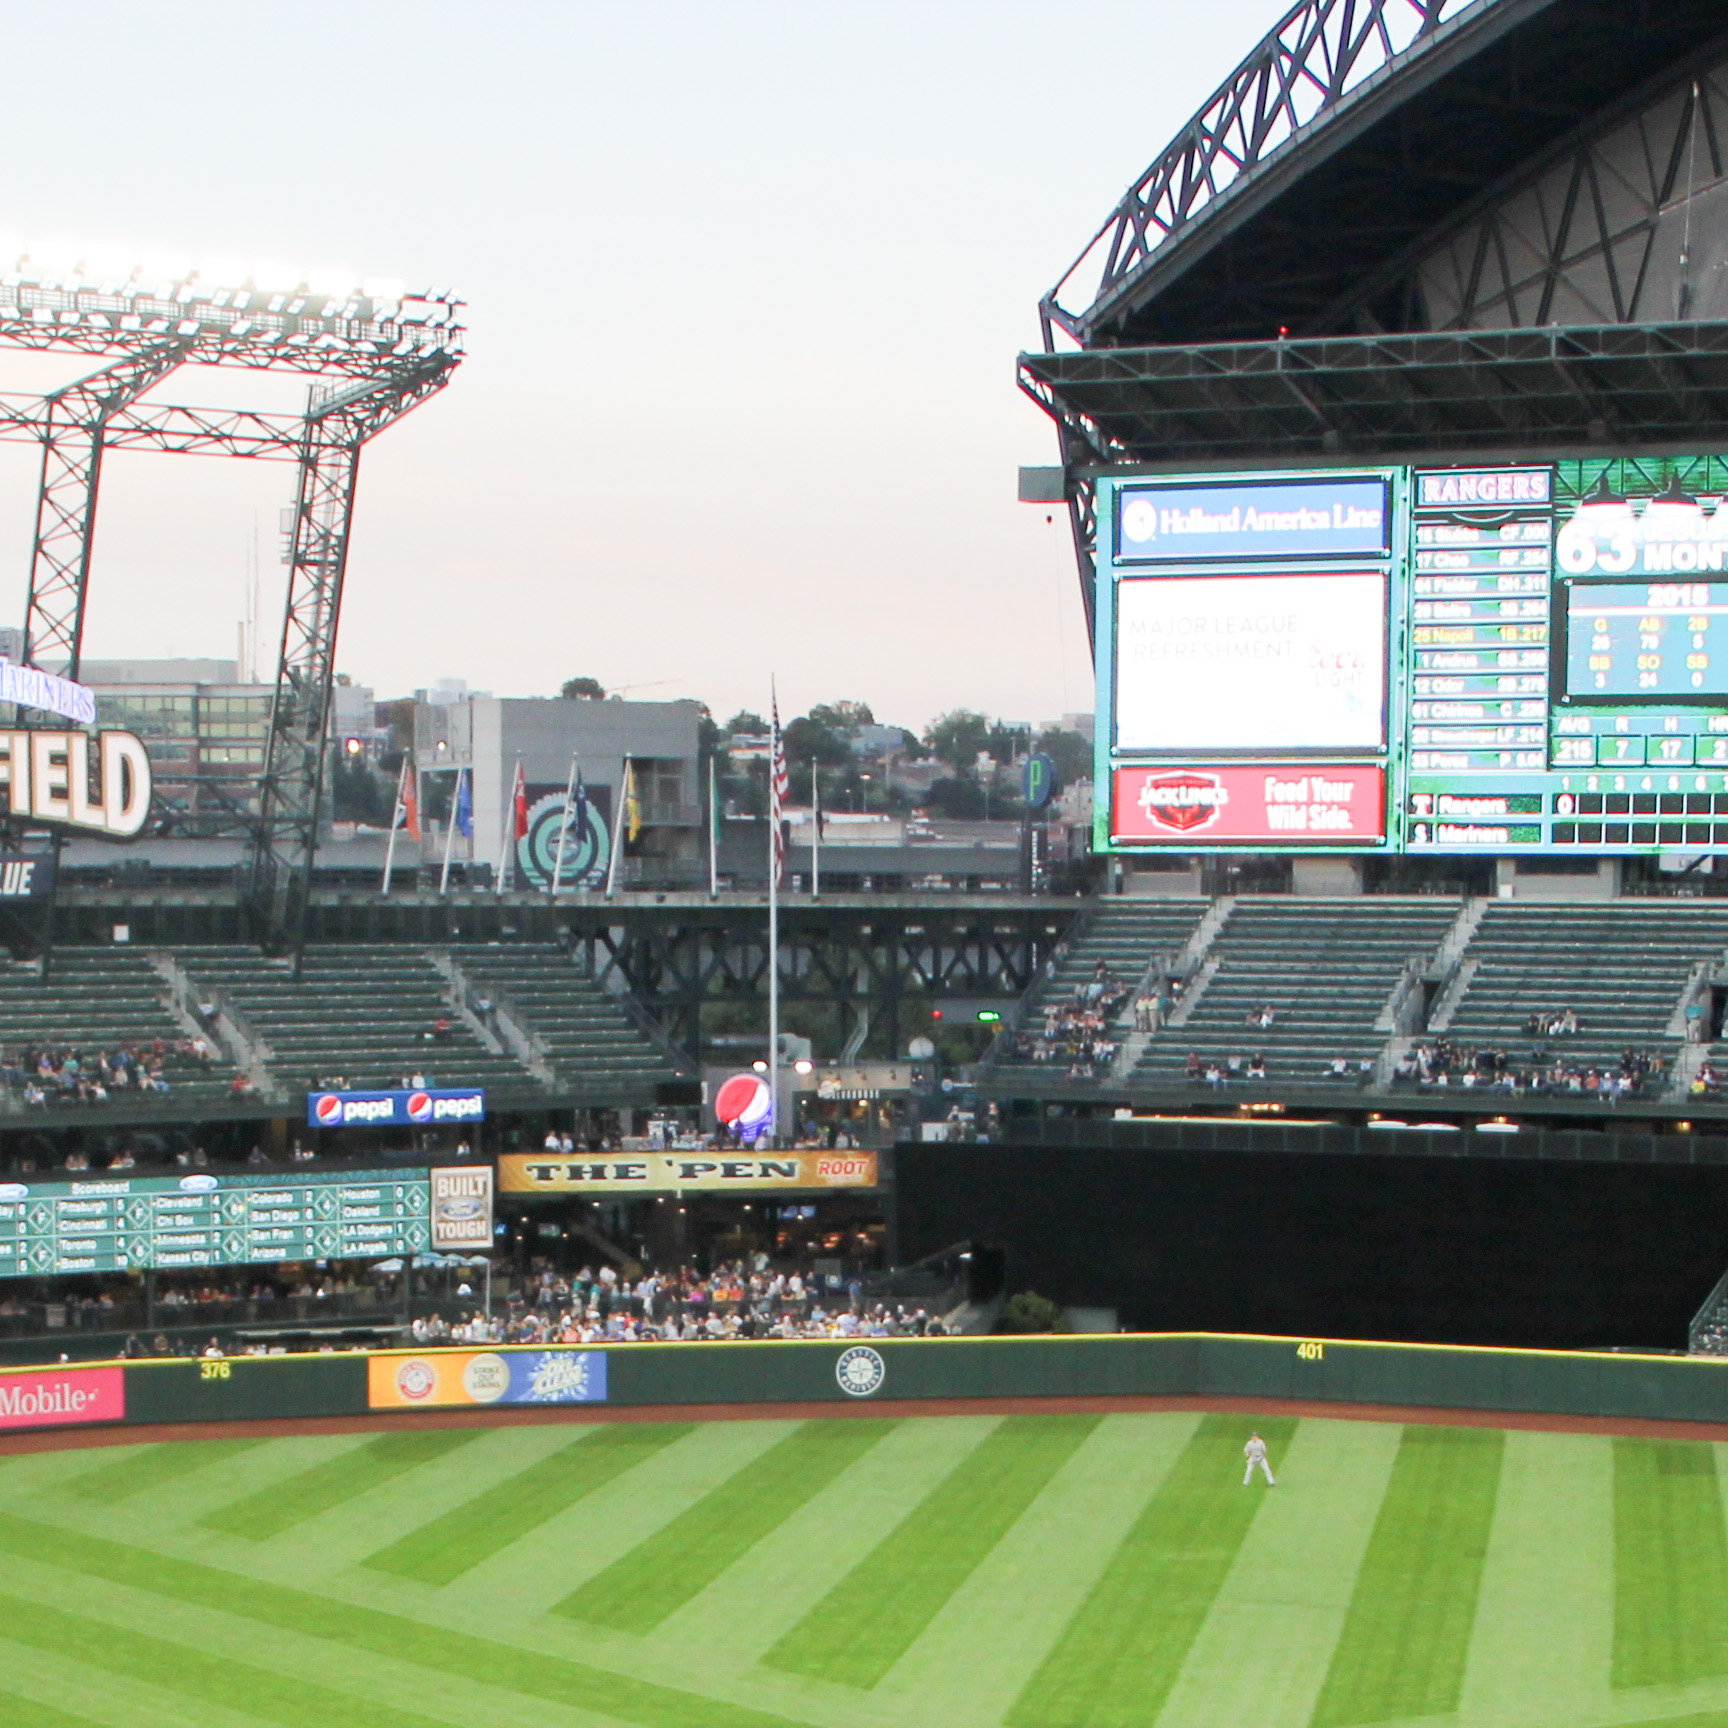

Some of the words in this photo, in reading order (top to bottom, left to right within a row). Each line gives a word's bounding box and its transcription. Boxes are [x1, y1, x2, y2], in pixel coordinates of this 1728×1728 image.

[1424, 473, 1546, 502] RANGERS
[1160, 507, 1240, 535] Holland
[1242, 504, 1329, 532] America
[1332, 503, 1380, 529] Line
[1556, 517, 1637, 573] 63
[1647, 583, 1710, 606] 2015
[1558, 716, 1591, 732] AVG
[1557, 740, 1592, 759] .215
[1616, 739, 1628, 757] 7
[1660, 739, 1682, 757] 17
[1713, 739, 1728, 757] 2
[1264, 776, 1308, 804] Feed
[1310, 776, 1355, 803] Your
[1267, 803, 1309, 830] Wild
[1439, 795, 1509, 817] Rangers
[1439, 823, 1509, 843] Mariners
[343, 1098, 394, 1122] pepsi
[434, 1095, 483, 1119] pepsi
[526, 1162, 648, 1181] THE
[817, 1158, 869, 1177] ROOT
[71, 1181, 130, 1195] Scoreboard
[436, 1175, 488, 1197] BUILT
[436, 1219, 488, 1240] TOUGH
[1297, 1343, 1324, 1360] 401
[200, 1361, 231, 1380] 376
